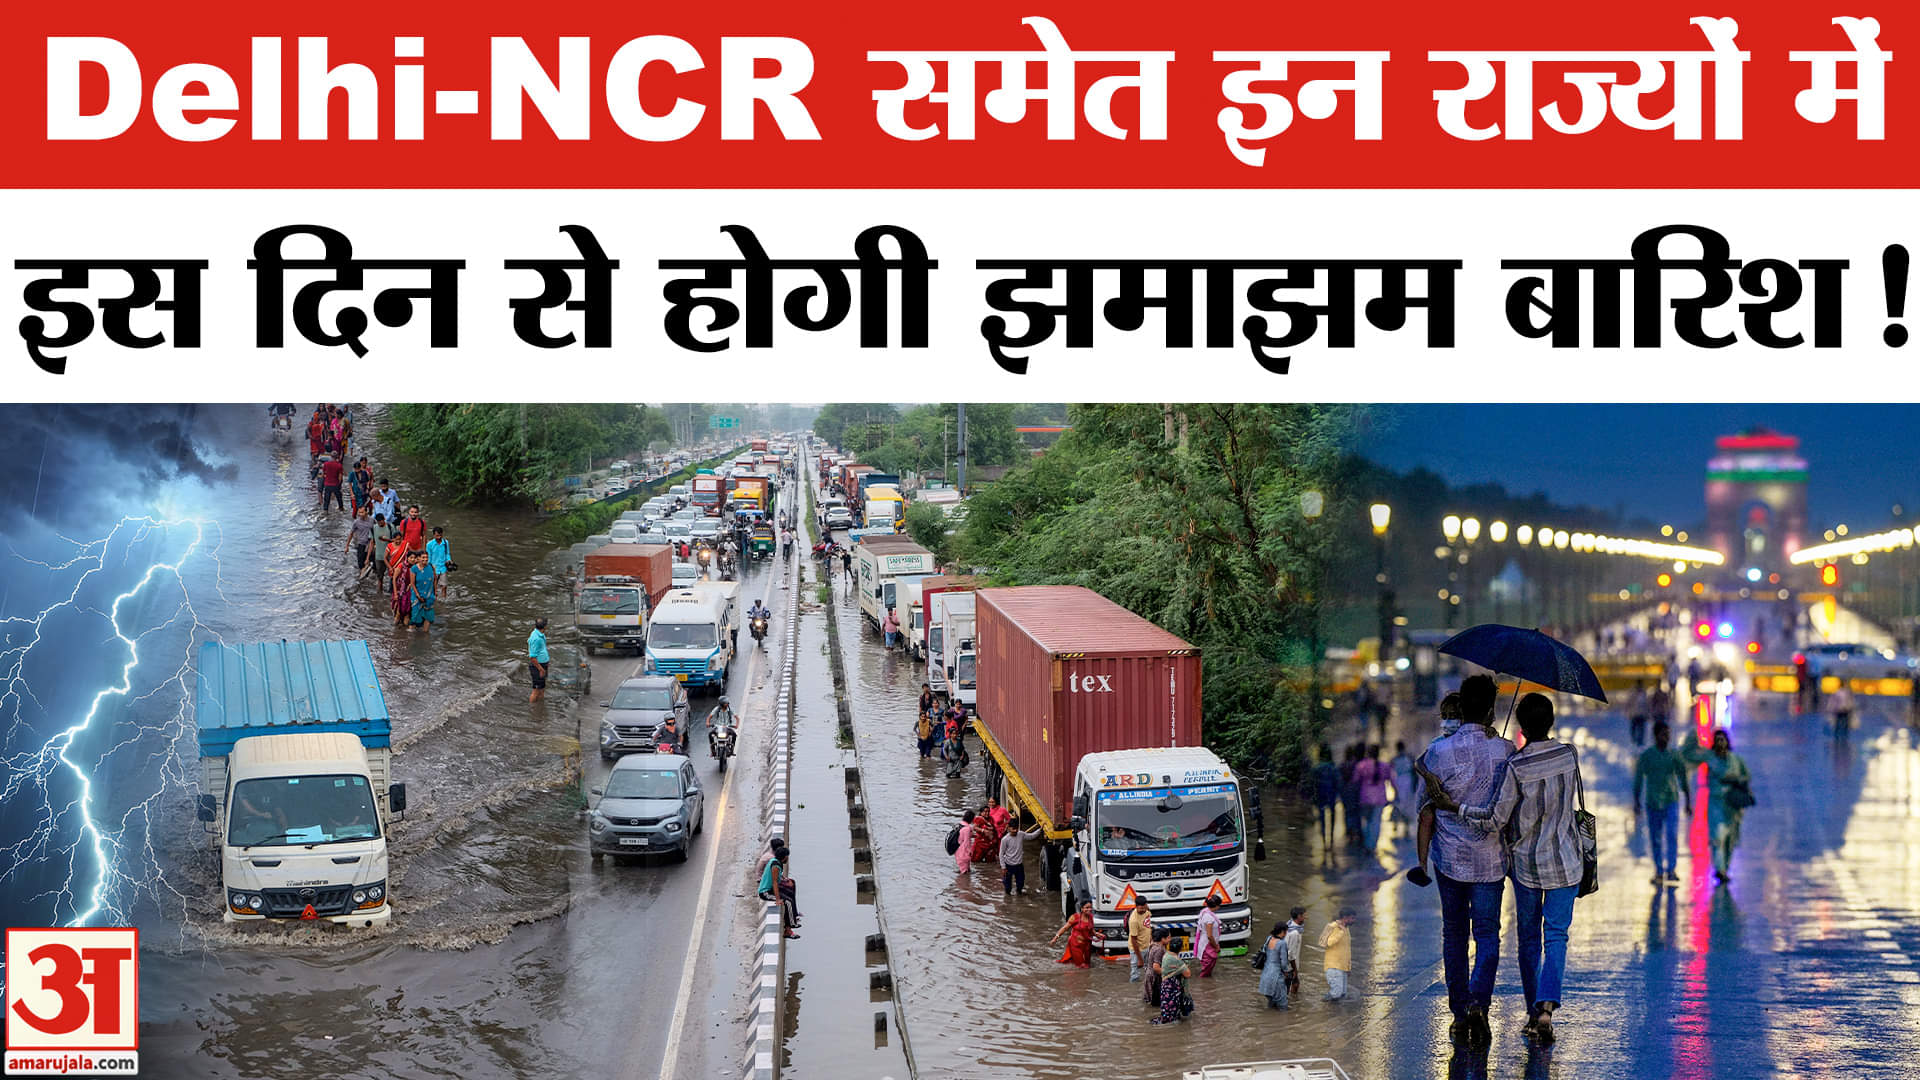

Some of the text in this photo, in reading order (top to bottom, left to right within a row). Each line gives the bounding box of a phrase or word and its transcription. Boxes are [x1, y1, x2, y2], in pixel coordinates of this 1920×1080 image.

[1069, 671, 1113, 693] tex
[1104, 772, 1153, 787] ARD
[1187, 786, 1220, 795] PERMIT
[1133, 871, 1168, 880] ASHOK
